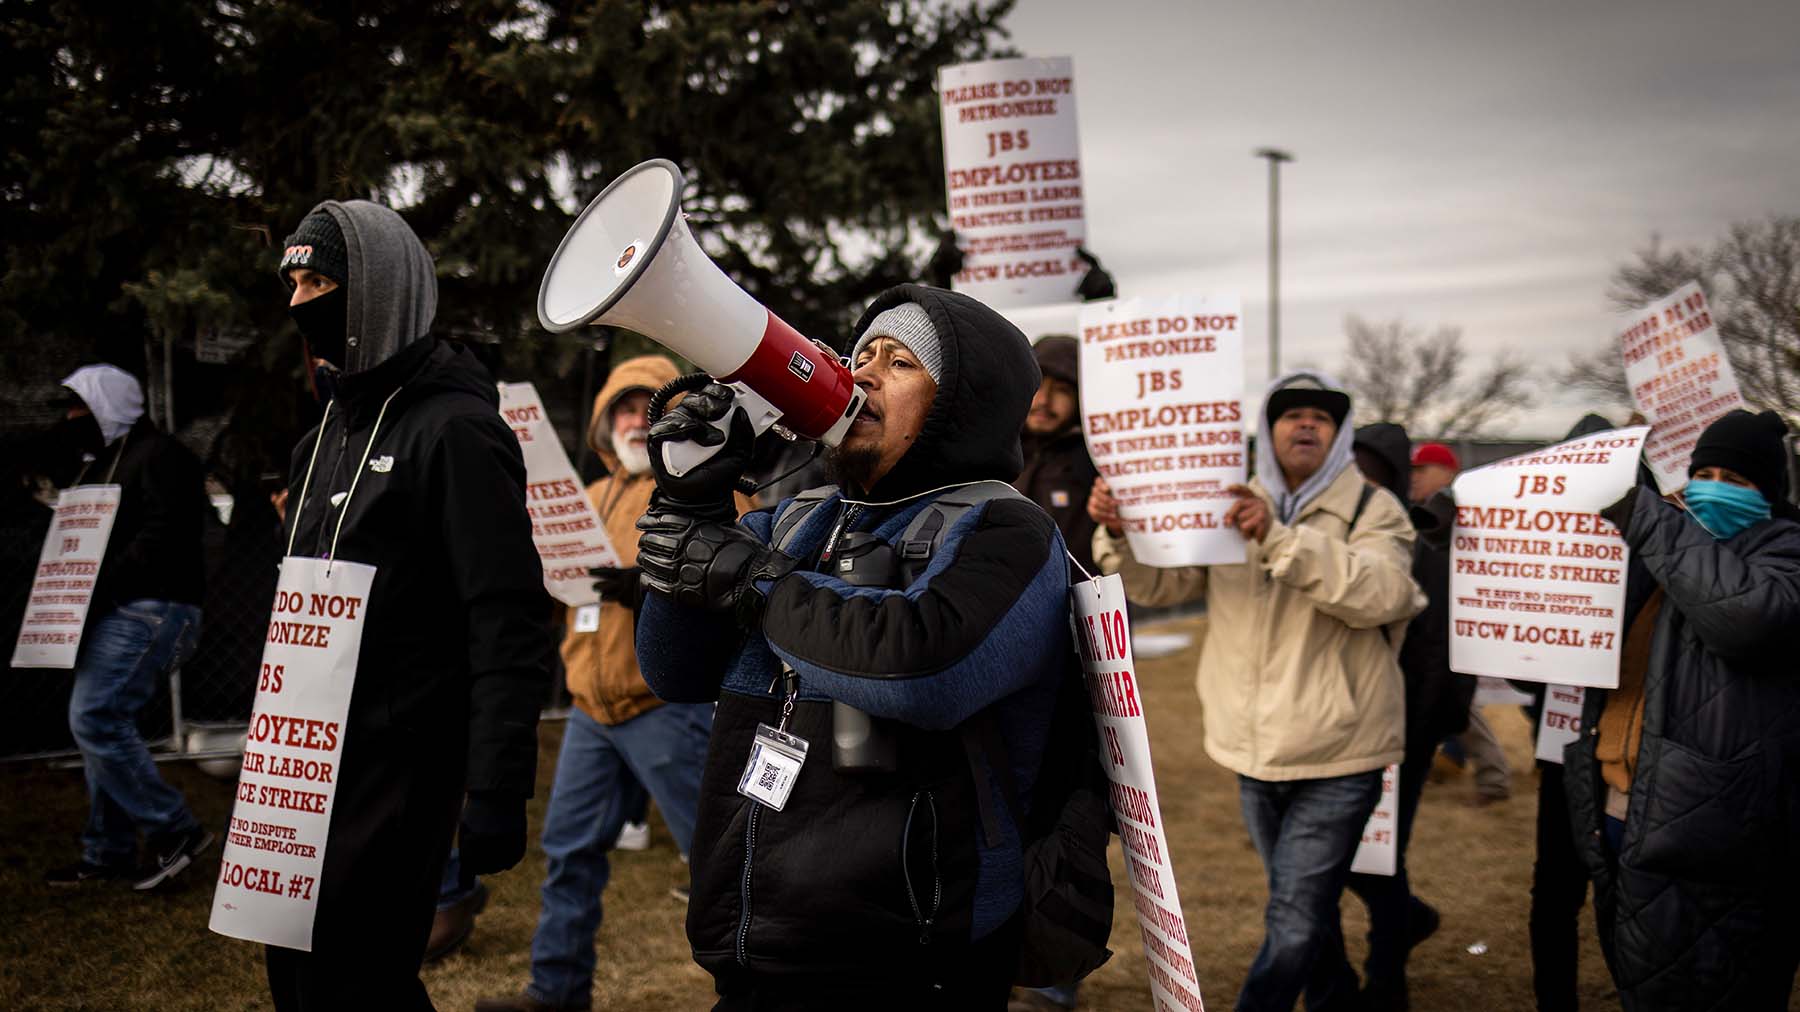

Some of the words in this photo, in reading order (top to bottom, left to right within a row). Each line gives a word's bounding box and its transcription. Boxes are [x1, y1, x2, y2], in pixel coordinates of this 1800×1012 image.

[1003, 80, 1033, 97] DO
[1035, 78, 1072, 95] NOT
[959, 99, 1057, 122] PATRONIZE
[987, 129, 1030, 158] JBS
[950, 160, 1080, 189] EMPLOYEES
[1031, 186, 1081, 202] LABOR
[1029, 205, 1083, 221] STRIKE
[1004, 260, 1066, 279] LOCAL
[1084, 320, 1151, 344] PLEASE
[1157, 317, 1188, 334] DO
[1194, 316, 1238, 332] NOT
[1104, 337, 1216, 362] PATRONIZE
[1657, 346, 1684, 369] JBS
[1136, 369, 1183, 399] JBS
[504, 405, 539, 424] NOT
[1088, 401, 1242, 435] EMPLOYEES
[1093, 442, 1113, 457] ON
[1116, 435, 1177, 454] UNFAIR
[1183, 430, 1242, 448] LABOR
[1593, 438, 1640, 450] NOT
[1179, 453, 1242, 470] STRIKE
[1515, 475, 1567, 499] JBS
[540, 501, 586, 519] LABOR
[543, 518, 595, 537] STRIKE
[1150, 512, 1218, 533] LOCAL
[1455, 536, 1480, 553] ON
[1485, 538, 1552, 556] UNFAIR
[1557, 541, 1623, 561] LABOR
[1456, 560, 1545, 580] PRACTICE
[1549, 565, 1621, 585] STRIKE
[278, 591, 303, 613] DO
[309, 593, 362, 620] NOT
[1457, 597, 1483, 608] WITH
[1486, 600, 1506, 610] ANY
[1509, 602, 1545, 613] OTHER
[1549, 605, 1614, 618] EMPLOYER
[1475, 588, 1491, 598] WE
[1494, 589, 1521, 600] HAVE
[1524, 591, 1540, 602] NO
[1544, 593, 1592, 605] DISPUTE
[1100, 609, 1126, 660] NO
[1455, 619, 1509, 640] UFCW
[1513, 624, 1584, 647] LOCAL
[1589, 631, 1615, 650] #7
[267, 755, 333, 783] LABOR
[259, 786, 328, 814] STRIKE
[251, 822, 297, 840] DISPUTE
[254, 837, 316, 858] EMPLOYER
[1144, 832, 1163, 865] POR
[223, 862, 284, 895] LOCAL
[288, 874, 315, 900] #7
